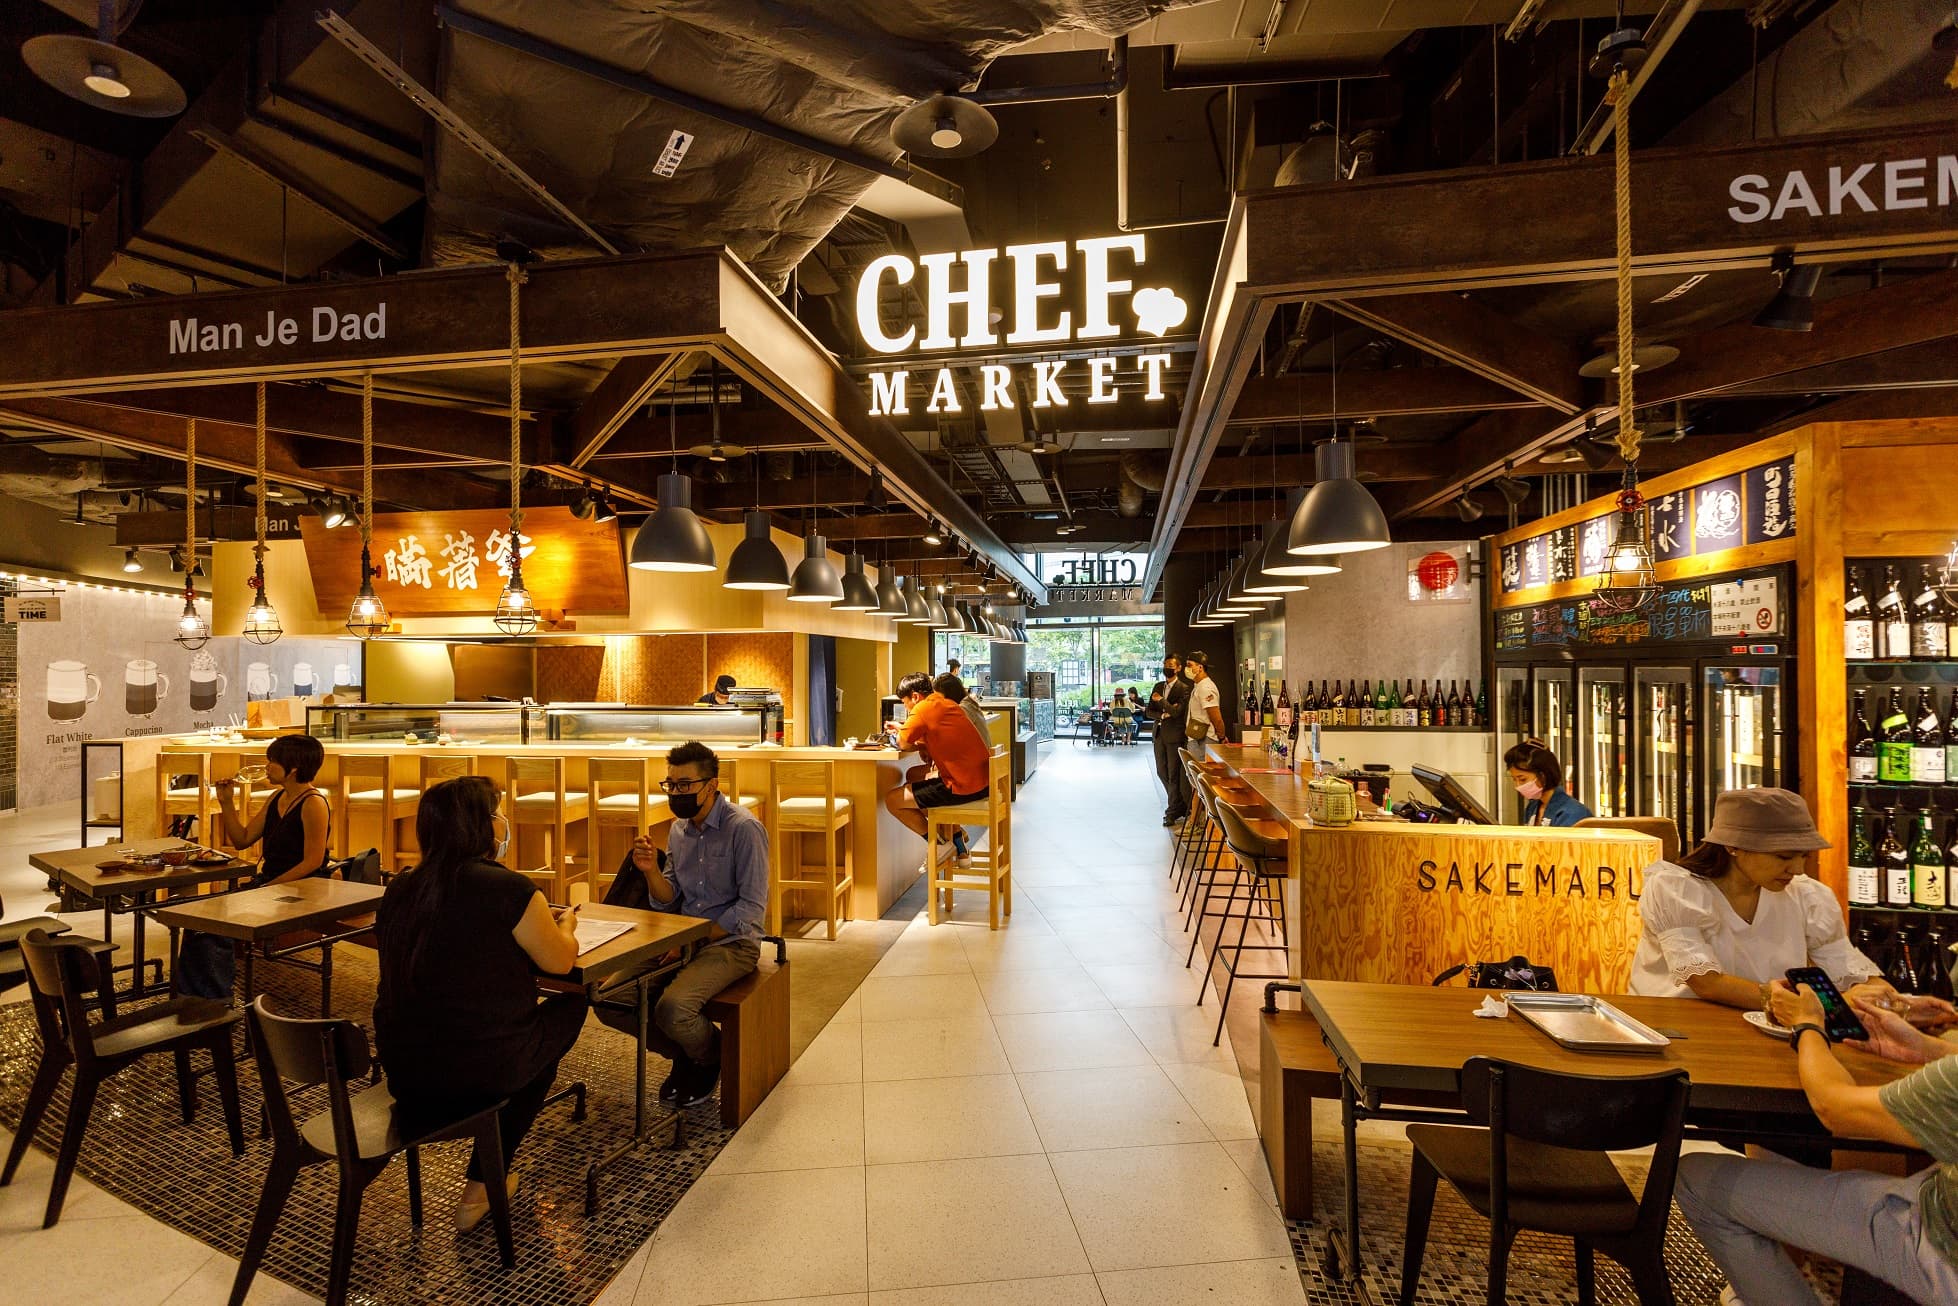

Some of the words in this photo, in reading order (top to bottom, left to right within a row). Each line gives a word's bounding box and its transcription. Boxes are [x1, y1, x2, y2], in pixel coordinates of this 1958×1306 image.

[856, 233, 1146, 353] CHEF
[169, 317, 243, 354] Man
[255, 310, 298, 347] Je
[312, 302, 386, 343] Dad
[868, 353, 1171, 416] MARKET
[18, 611, 47, 620] TIME
[46, 733, 64, 745] Flat
[66, 732, 93, 744] White
[192, 720, 214, 730] Mocha
